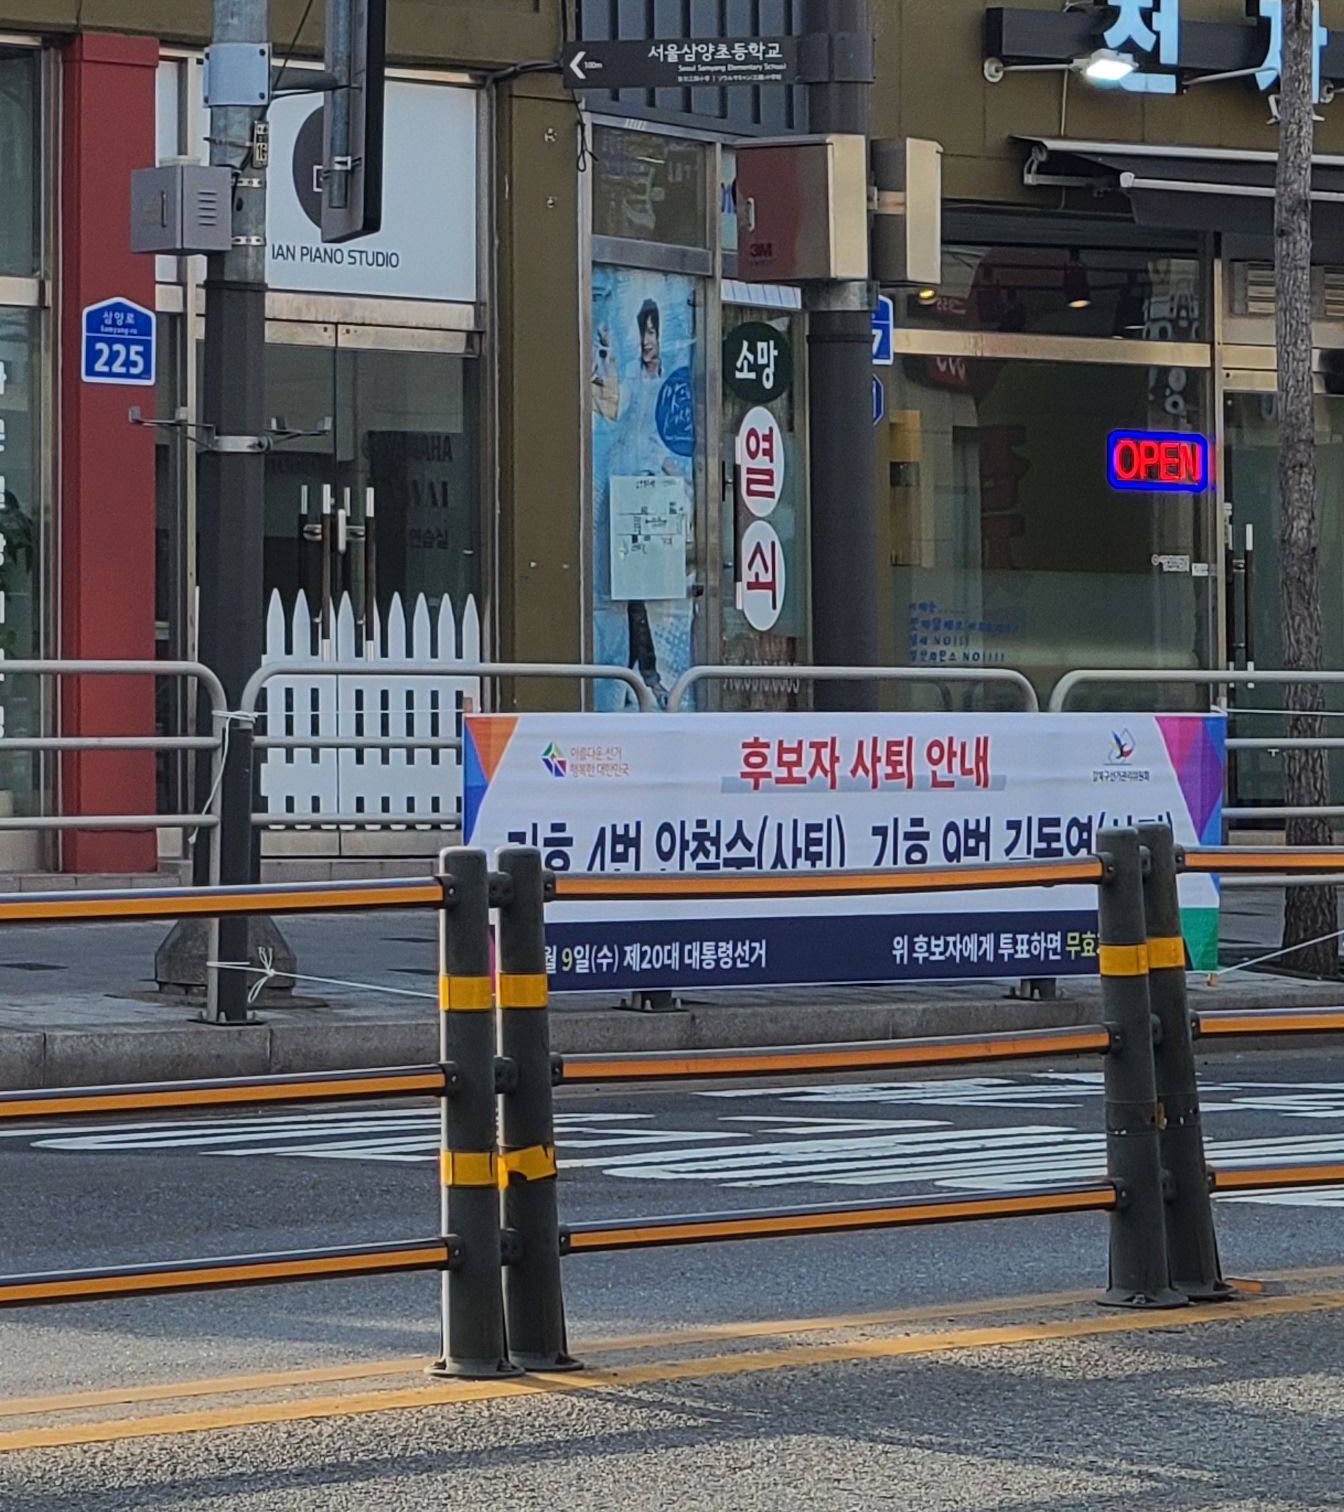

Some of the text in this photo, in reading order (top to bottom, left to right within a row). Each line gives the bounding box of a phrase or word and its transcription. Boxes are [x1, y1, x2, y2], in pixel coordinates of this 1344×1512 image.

[648, 42, 783, 63] 서울삼양초등학교
[272, 244, 400, 268] IAN PIANO STUDIO
[103, 311, 135, 326] 삼양로
[94, 342, 144, 374] 225
[735, 340, 778, 390] 소망
[1114, 439, 1202, 481] OPEN
[571, 746, 622, 761] 아름다운 선거
[740, 735, 989, 791] 후보자 사퇴 안내
[570, 763, 629, 777] 행복한 대한민국
[562, 944, 619, 973] 9일(수)
[623, 942, 680, 972] 제20대
[684, 939, 767, 970] 대통령선거
[892, 931, 1100, 965] 위 후보자에게 투표하면 무효
